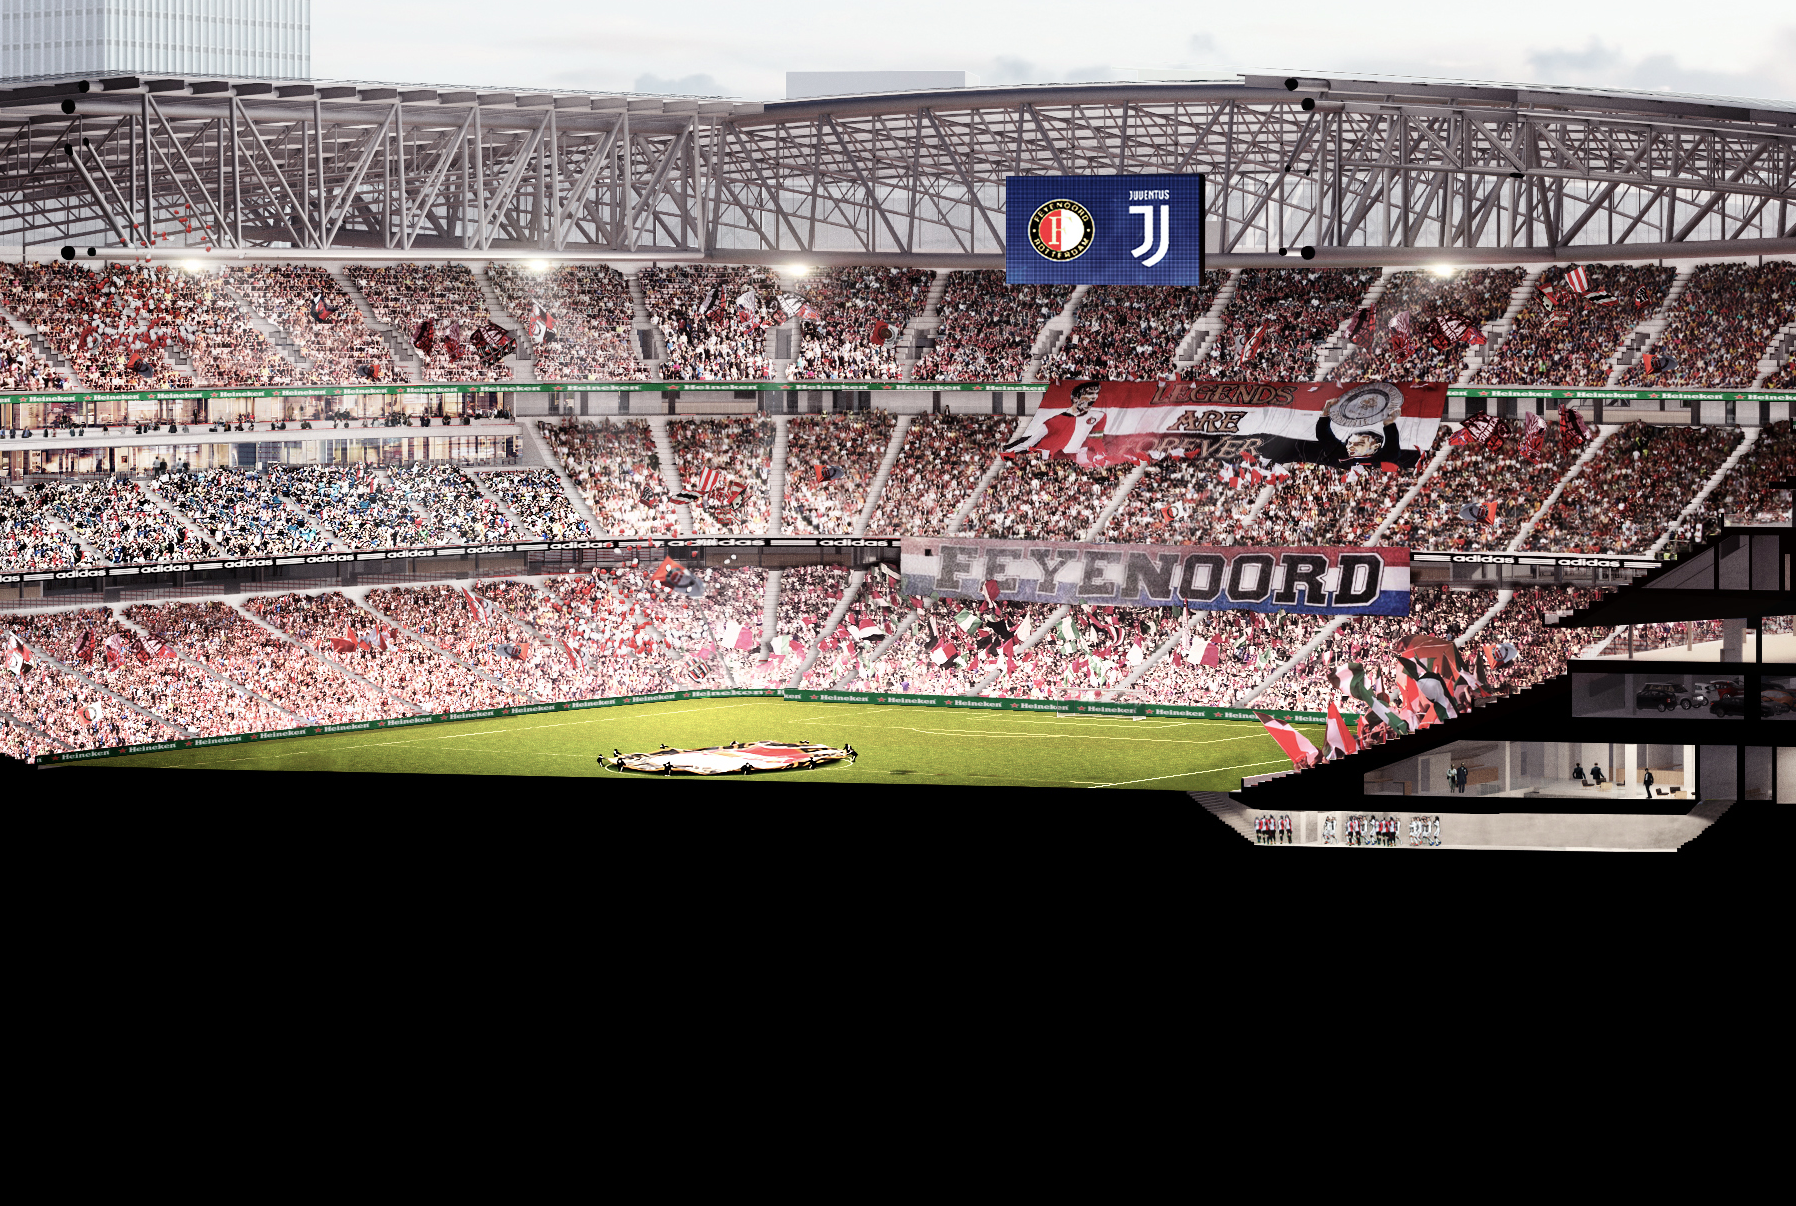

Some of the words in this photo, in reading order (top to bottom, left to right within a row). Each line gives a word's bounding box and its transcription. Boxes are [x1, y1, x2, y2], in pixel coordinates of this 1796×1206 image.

[1129, 189, 1170, 201] JUVENTUS
[1033, 202, 1090, 223] FEYENOORD
[1033, 237, 1090, 259] ROTTERDAM
[1150, 384, 1299, 406] LEGENDS
[1167, 410, 1248, 433] ARE
[56, 569, 106, 579] adidas
[141, 564, 190, 574] adidas
[224, 559, 274, 568] adidas
[306, 554, 354, 564] adidas
[387, 549, 434, 559] adidas
[467, 545, 513, 554] adidas
[550, 541, 614, 549] adidas
[1453, 555, 1514, 564] adidas
[1557, 559, 1620, 568] adidas
[933, 545, 1385, 606] FEYENOORD
[887, 697, 936, 705] Heineken
[954, 700, 1002, 708] Heineken
[1021, 702, 1069, 711] Heineken
[1087, 706, 1137, 714] Heineken
[1156, 708, 1205, 717] Heineken
[62, 750, 109, 761] Heineken
[129, 743, 177, 753] Heineken
[195, 735, 242, 746] Heineken
[260, 728, 306, 739] Heineken
[324, 722, 370, 732] Heineken
[387, 716, 432, 726] Heineken
[449, 710, 494, 720] Heineken
[511, 705, 555, 714] Heineken
[572, 699, 615, 708] Heineken
[633, 694, 676, 702] Heineken
